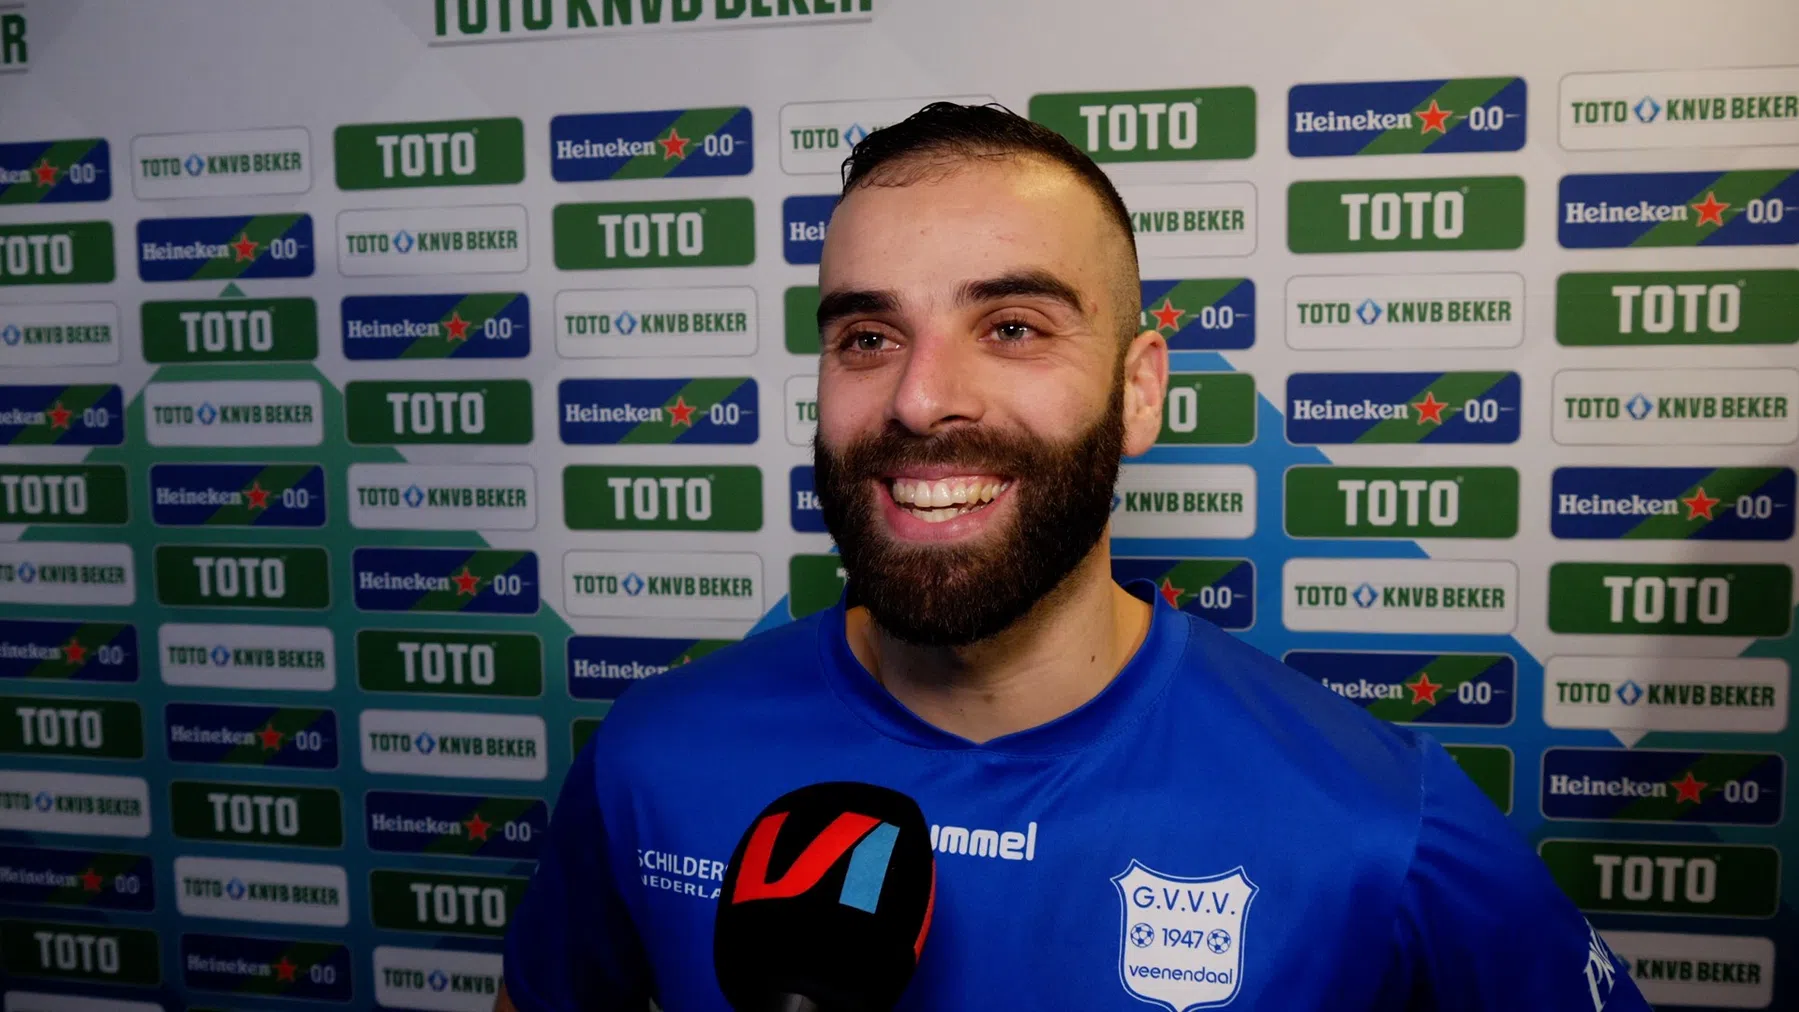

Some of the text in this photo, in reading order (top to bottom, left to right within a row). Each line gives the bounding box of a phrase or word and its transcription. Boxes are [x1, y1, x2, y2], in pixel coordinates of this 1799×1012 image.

[1296, 110, 1412, 132] Heineken
[1572, 96, 1798, 123] TOTO KNVB BEKER
[790, 129, 839, 149] TOTO
[1080, 103, 1197, 152] TOTO
[377, 133, 476, 178] TOTO
[556, 139, 656, 159] Heineken
[141, 152, 302, 177] TOTO KNVB BEKER
[1184, 210, 1244, 231] BEKER
[1341, 191, 1463, 240] TOTO
[1566, 201, 1687, 223] Heineken
[346, 230, 518, 254] TOTO KNVB BEKER
[598, 212, 703, 258] TOTO
[142, 242, 230, 260] Heineken
[1298, 300, 1511, 324] TOTO KNVB BEKER
[1612, 284, 1740, 333] TOTO
[24, 325, 111, 343] KNVB BEKER
[180, 310, 273, 353] TOTO
[348, 320, 440, 339] Heineken
[565, 312, 747, 334] TOTO KNVB BEKER
[154, 405, 313, 424] TOTO KNVB BEKER
[386, 392, 485, 435] TOTO
[565, 403, 663, 423] Heineken
[1294, 400, 1409, 420] Heineken
[1565, 396, 1787, 419] TOTO KNVB BEKER
[1, 476, 87, 514] TOTO
[156, 487, 243, 506] Heineken
[358, 487, 527, 508] TOTO KNVB BEKER
[608, 478, 711, 521] TOTO
[1125, 492, 1243, 513] KNVB BEKER
[1339, 480, 1459, 526] TOTO
[1559, 494, 1678, 515] Heineken
[39, 565, 78, 583] KNVB
[81, 566, 125, 584] BEKER
[194, 558, 284, 598] TOTO
[359, 572, 451, 592] Heineken
[574, 575, 753, 597] TOTO KNVB BEKER
[1295, 585, 1504, 608] TOTO KNVB BEKER
[1604, 576, 1729, 624] TOTO
[168, 646, 325, 669] TOTO KNVB BEKER
[398, 642, 495, 686] TOTO
[1557, 682, 1775, 707] TOTO KNVB BEKER
[17, 707, 102, 747] TOTO
[171, 725, 255, 746] Heineken
[369, 732, 536, 759] TOTO KNVB BEKER
[1551, 776, 1667, 798] Heineken
[97, 798, 142, 817] BEKER
[208, 793, 299, 836] TOTO
[371, 814, 461, 836] Heineken
[1594, 855, 1716, 902] TOTO
[183, 877, 339, 906] TOTO KNVB BEKER
[1133, 886, 1235, 915] G.V.V.V.
[410, 883, 507, 928] TOTO
[1162, 928, 1203, 948] 1947
[34, 931, 120, 974] TOTO
[188, 955, 271, 977] Heineken
[1129, 965, 1232, 984] veenendaal
[1636, 958, 1760, 984] KNVB BEKER
[383, 968, 495, 995] TOTO KNVB
